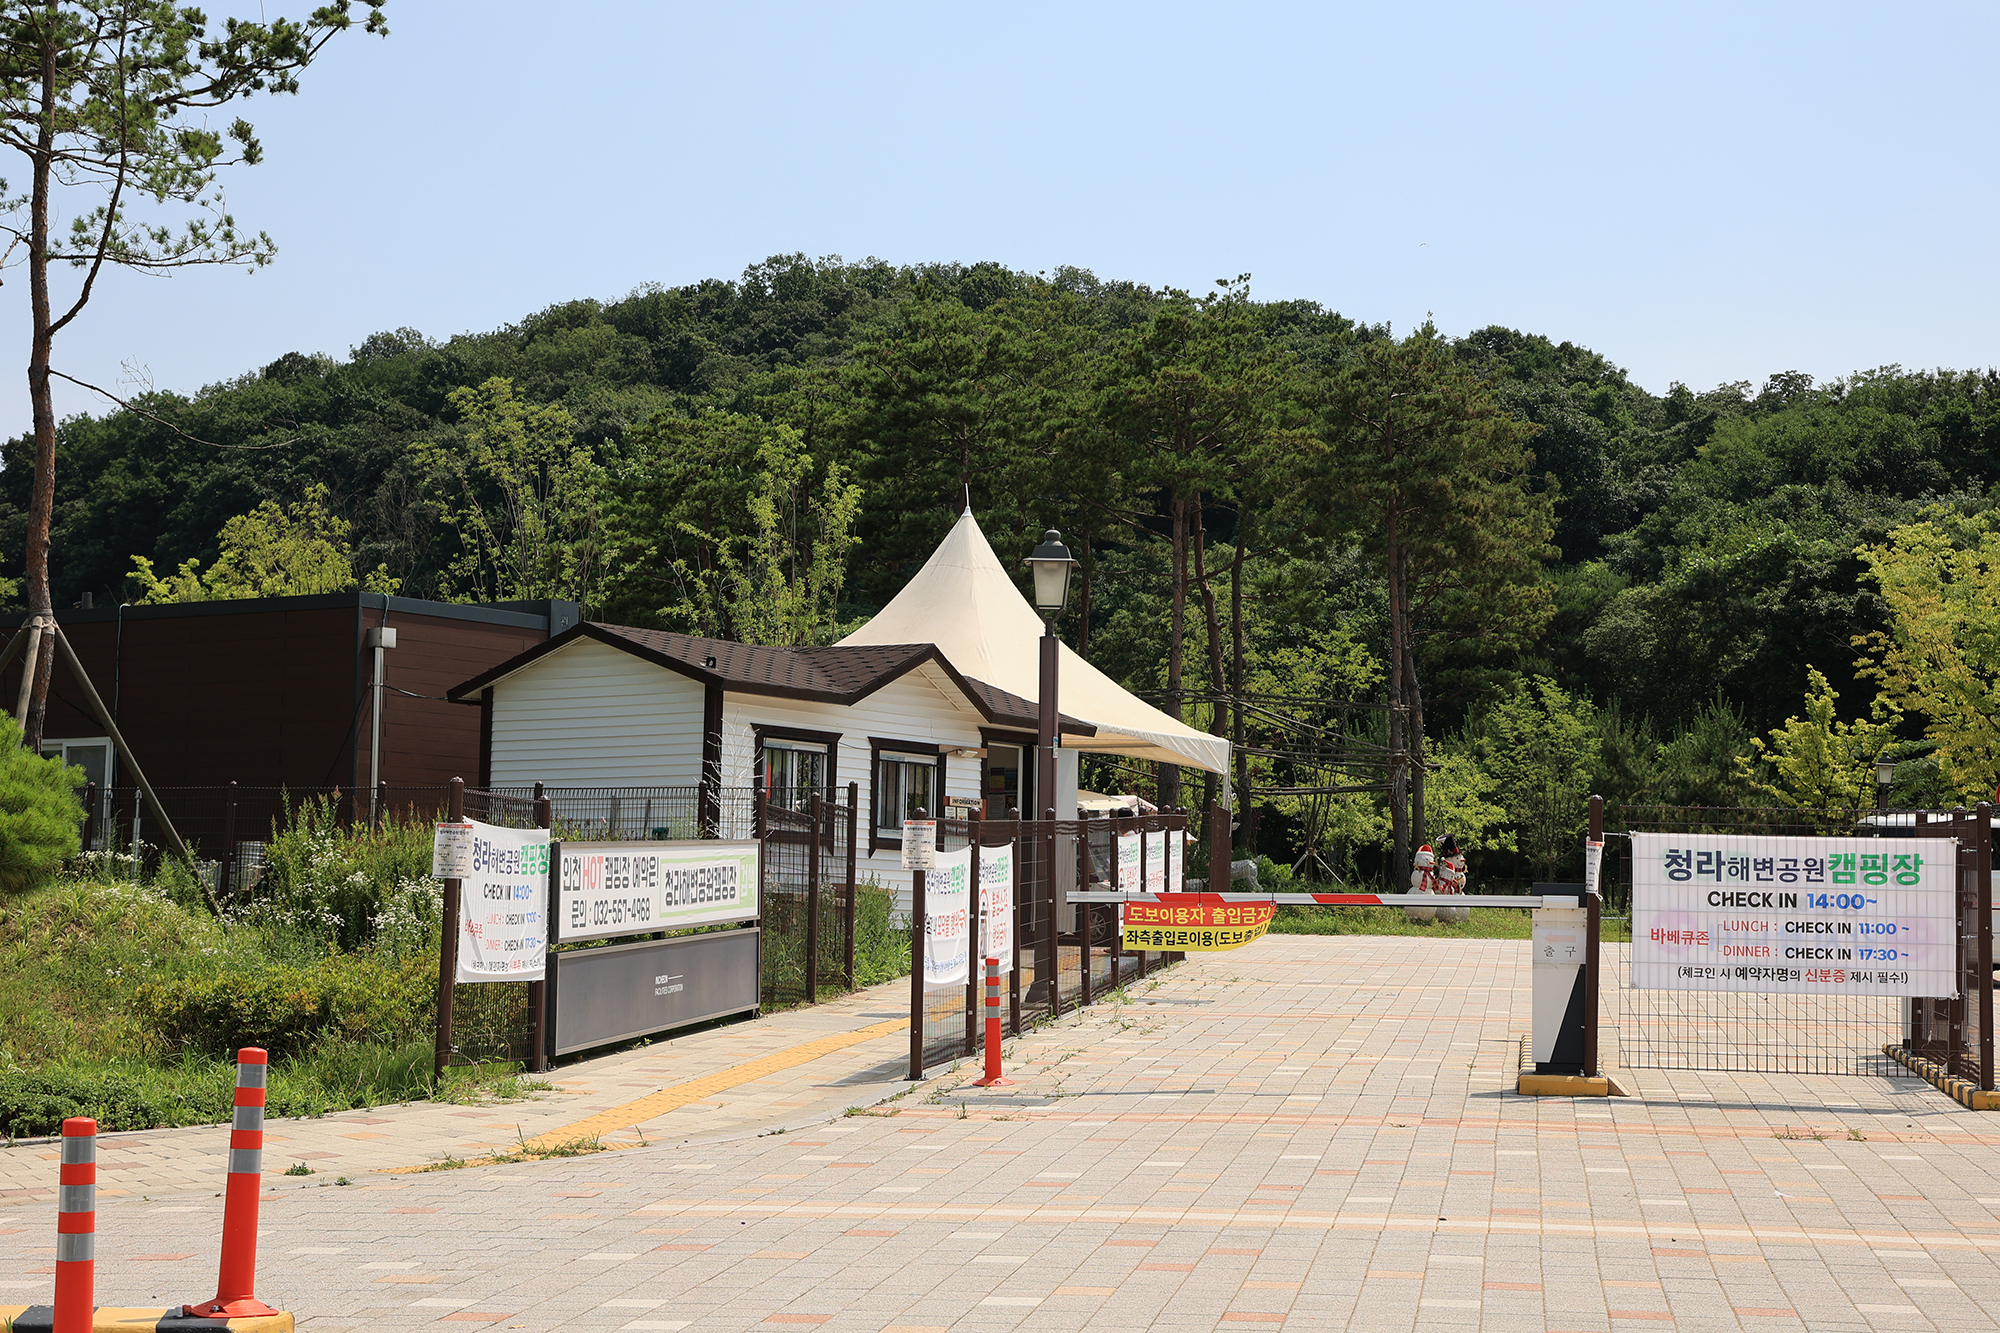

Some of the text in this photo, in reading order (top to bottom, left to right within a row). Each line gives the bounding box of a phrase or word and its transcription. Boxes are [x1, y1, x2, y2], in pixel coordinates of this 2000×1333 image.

[472, 837, 550, 875] 청라해변공원캠핑장
[1664, 848, 1924, 886] 청라해변공원캠핑장
[563, 856, 659, 891] 인천 HOT 캠핑장 예약은!
[741, 863, 755, 897] 검색
[484, 883, 504, 900] CHECK
[665, 865, 737, 906] 청라해변공원캠핑장
[1707, 890, 1773, 909] CHECK
[1778, 892, 1797, 908] IN
[572, 899, 587, 928] 문의
[593, 897, 650, 926] 032-567-4968
[1128, 906, 1272, 925] 도보이용자 출입금지
[1126, 922, 1268, 948] 좌측출입로이용(도보출입)
[1650, 928, 1710, 946] 바베큐존
[1723, 920, 1769, 932] LUNCH
[1784, 921, 1834, 934] CHECK
[1837, 922, 1852, 934] IN
[1858, 922, 1897, 935] 11:00
[1723, 945, 1771, 958] DINNER
[1784, 947, 1834, 960] CHECK
[1837, 948, 1852, 960] IN
[1858, 948, 1898, 961] 17:30
[1677, 966, 1909, 985] (체크인 시 예약자명의 신분증 제시 필수!)
